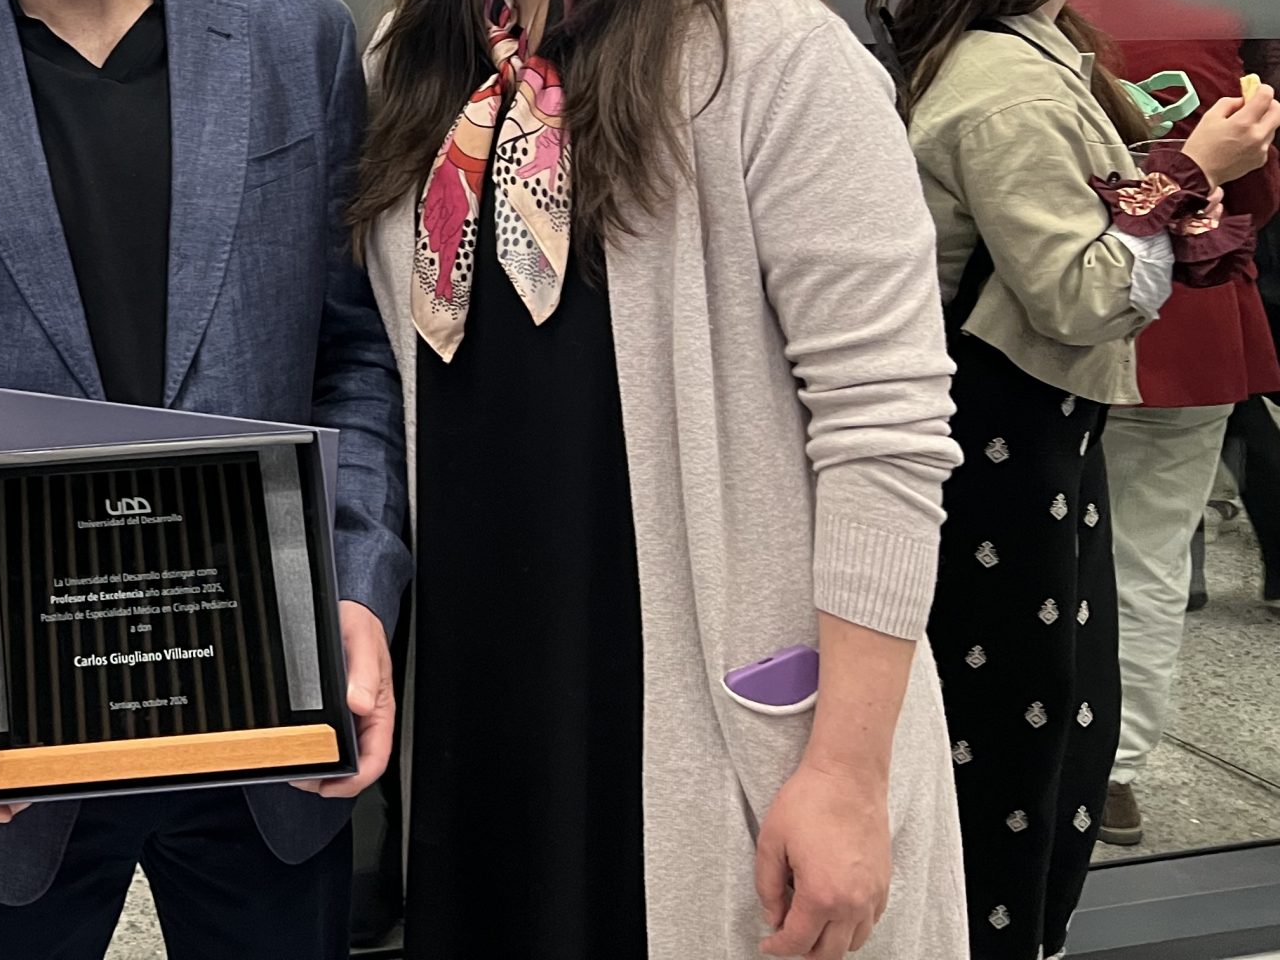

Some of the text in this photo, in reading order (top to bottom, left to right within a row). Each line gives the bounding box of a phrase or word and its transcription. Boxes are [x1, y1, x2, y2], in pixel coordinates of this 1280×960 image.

[77, 514, 183, 529] Universidad del Desarrollo
[53, 568, 218, 587] La Universidad del Desarrollo distingue como
[50, 594, 86, 604] Profesor
[86, 592, 99, 602] de
[99, 589, 144, 601] Excelencia
[74, 610, 85, 620] de
[130, 623, 152, 633] a don
[73, 645, 214, 667] Carlos Giugliano Villarroel
